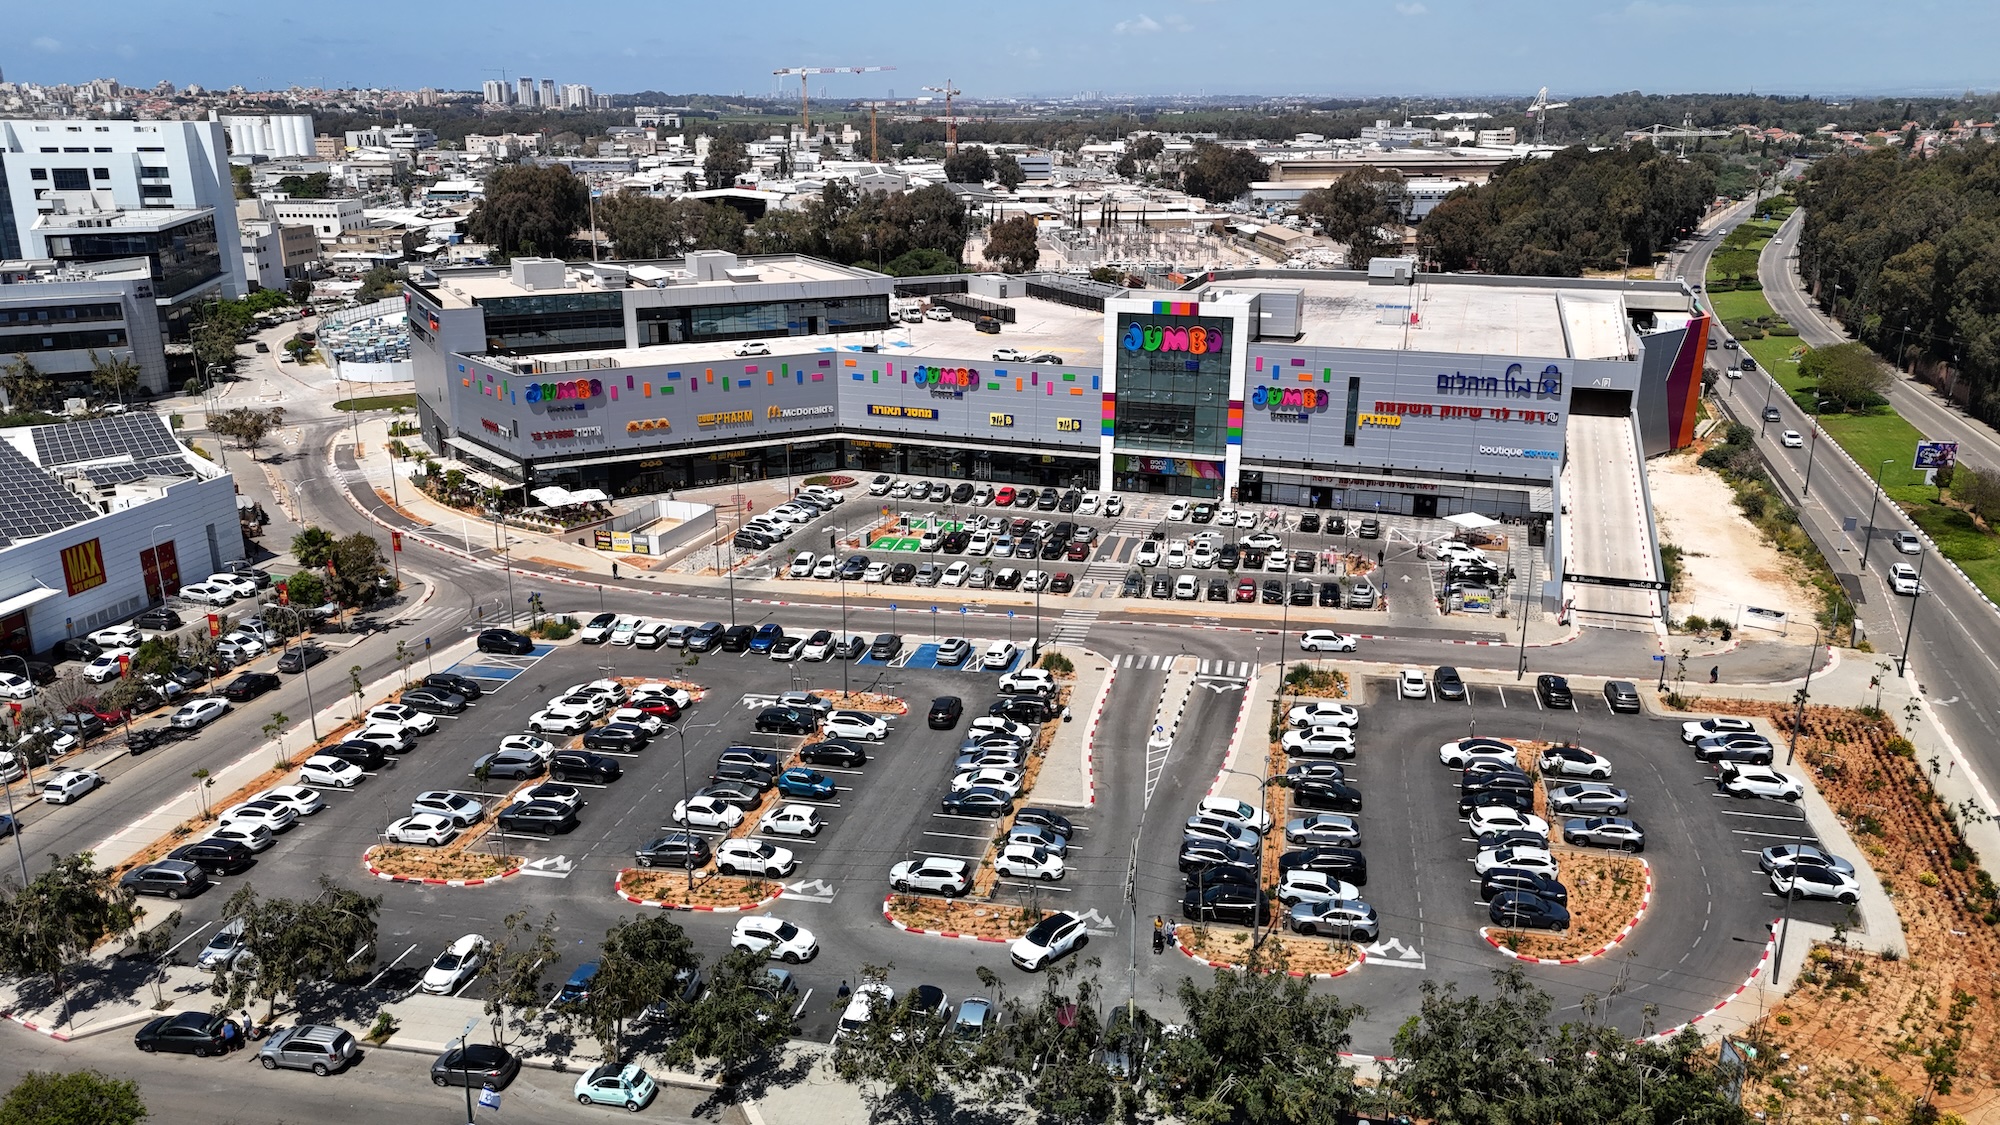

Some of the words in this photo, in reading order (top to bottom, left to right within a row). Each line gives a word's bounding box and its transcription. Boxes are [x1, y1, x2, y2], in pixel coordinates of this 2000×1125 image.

[1123, 321, 1223, 354] JUMBO
[913, 364, 979, 387] JUMBO
[1437, 371, 1498, 391] היהלום
[525, 378, 602, 403] JUMBO
[1252, 385, 1329, 408] JUMBO
[782, 405, 834, 418] McDonald's
[872, 405, 901, 416] תאורה
[904, 407, 932, 419] מחסני
[1375, 401, 1433, 416] השקמה
[1440, 405, 1482, 419] שיווק
[1490, 407, 1511, 420] לוי
[1519, 410, 1545, 422] רמי
[716, 409, 753, 424] PHARM
[1358, 413, 1402, 427] מהדרין
[575, 425, 602, 437] ארומה
[1479, 444, 1523, 457] boutique
[1523, 449, 1559, 460] central
[65, 540, 102, 584] MAX
